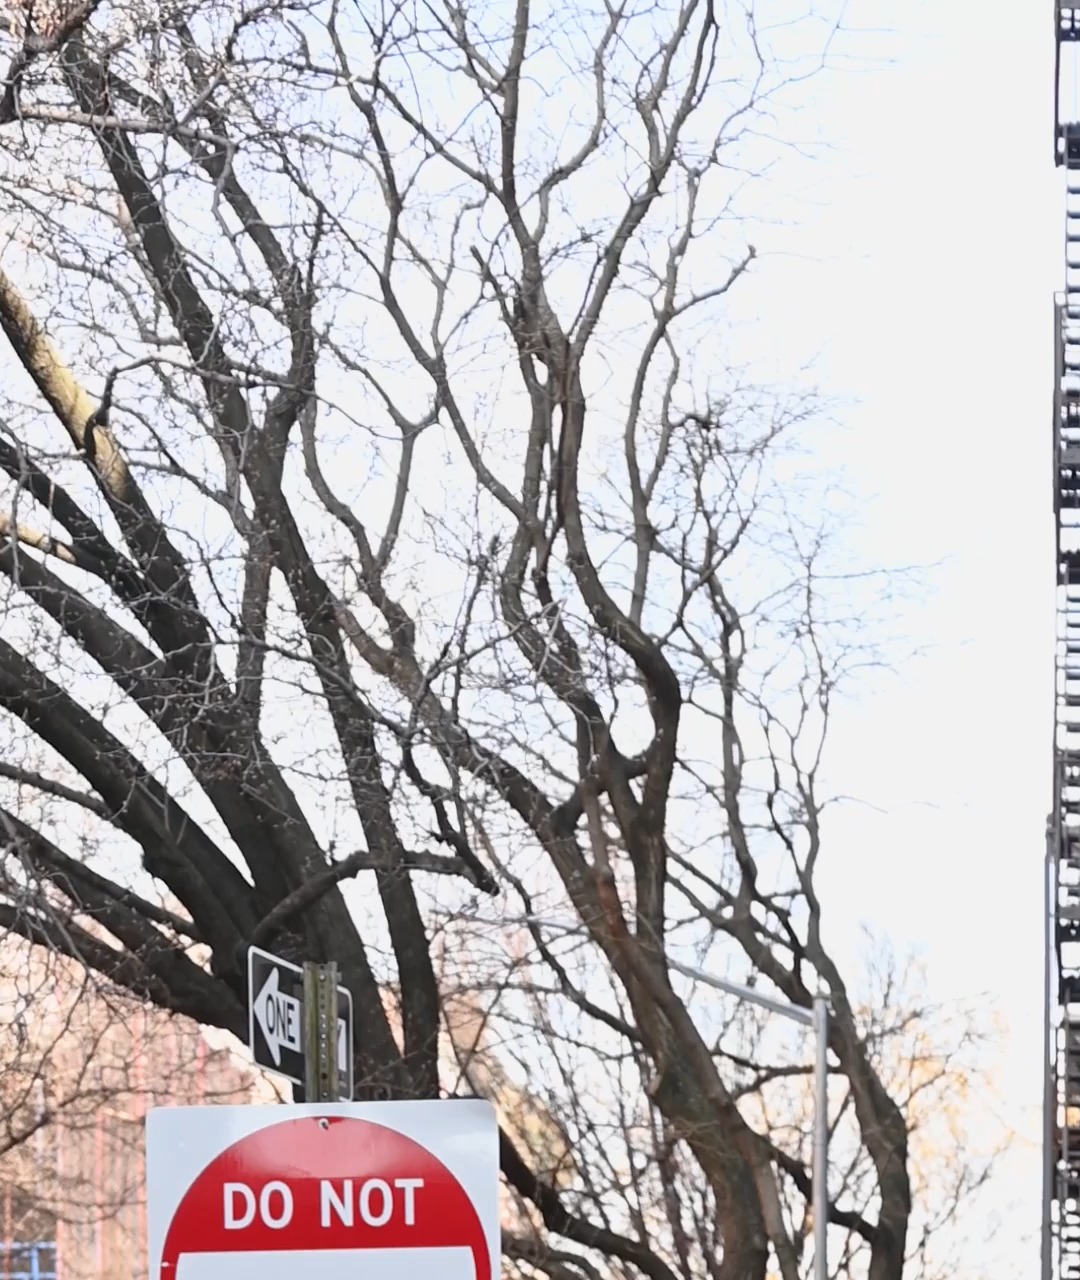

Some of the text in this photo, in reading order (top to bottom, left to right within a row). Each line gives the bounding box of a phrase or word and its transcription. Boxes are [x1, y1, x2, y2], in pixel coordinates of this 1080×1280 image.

[266, 993, 296, 1044] ONE
[223, 1178, 425, 1230] DO NOT
